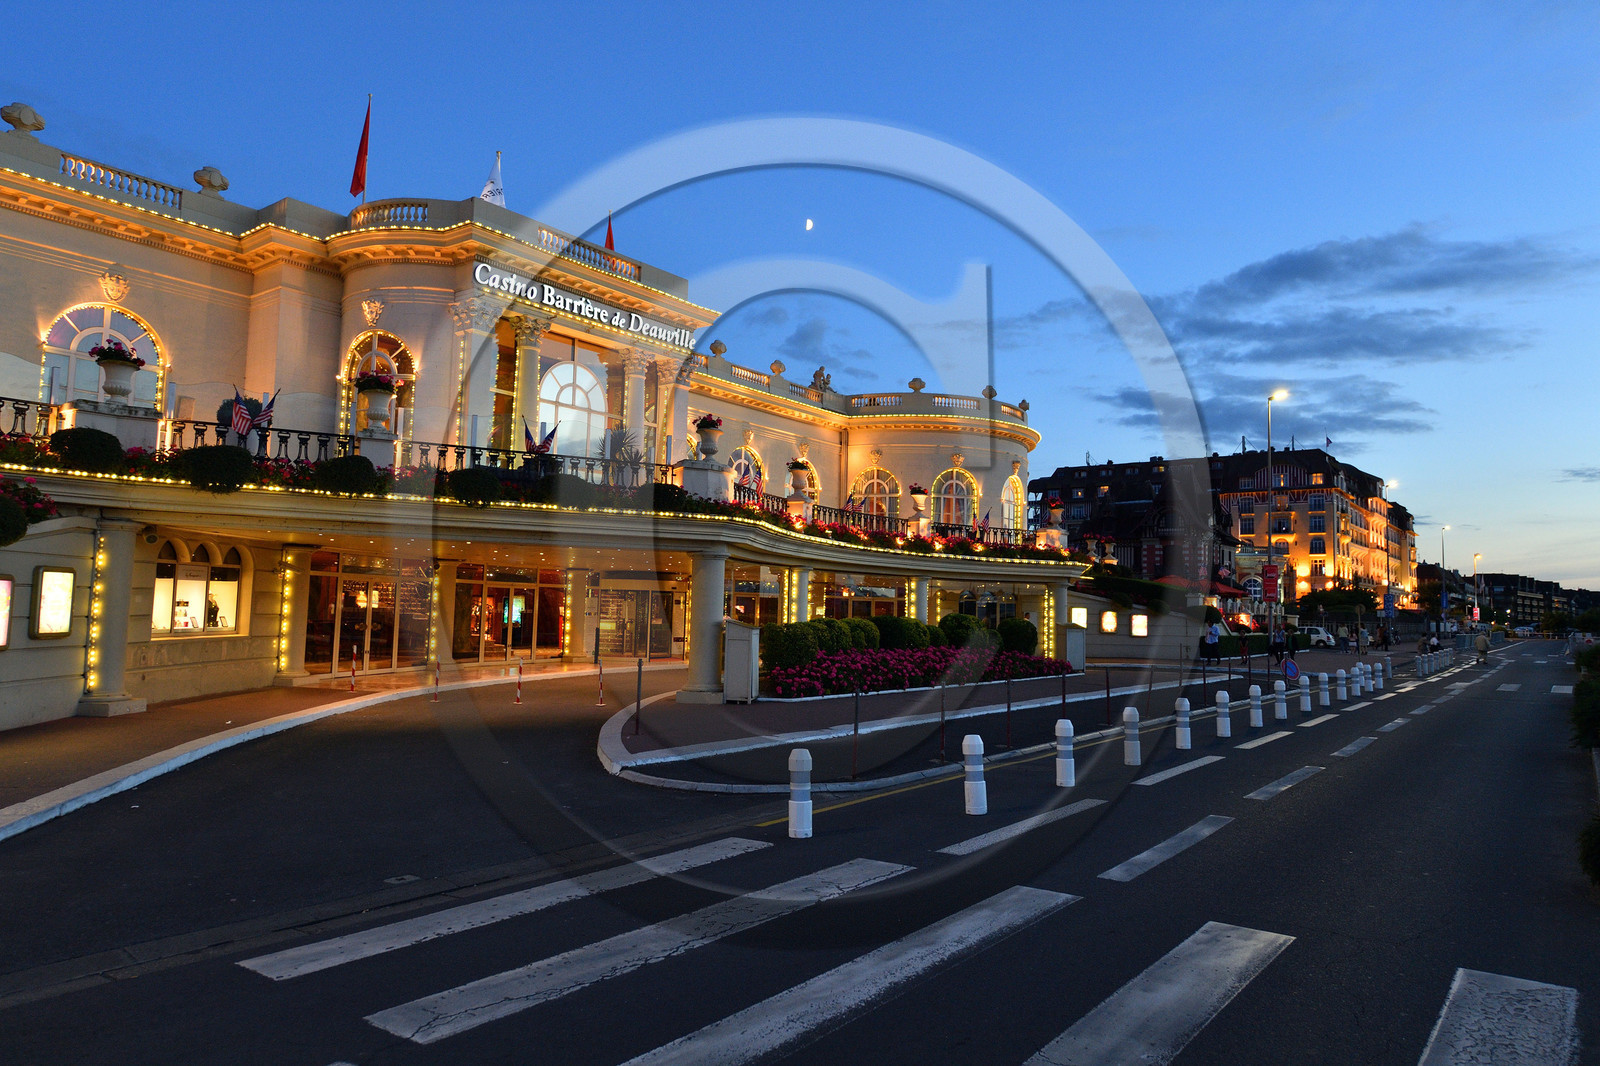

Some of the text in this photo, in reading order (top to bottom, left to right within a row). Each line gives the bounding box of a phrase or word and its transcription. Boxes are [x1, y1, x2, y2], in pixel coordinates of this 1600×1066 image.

[474, 263, 697, 350] Casino Barrière de Deauville
